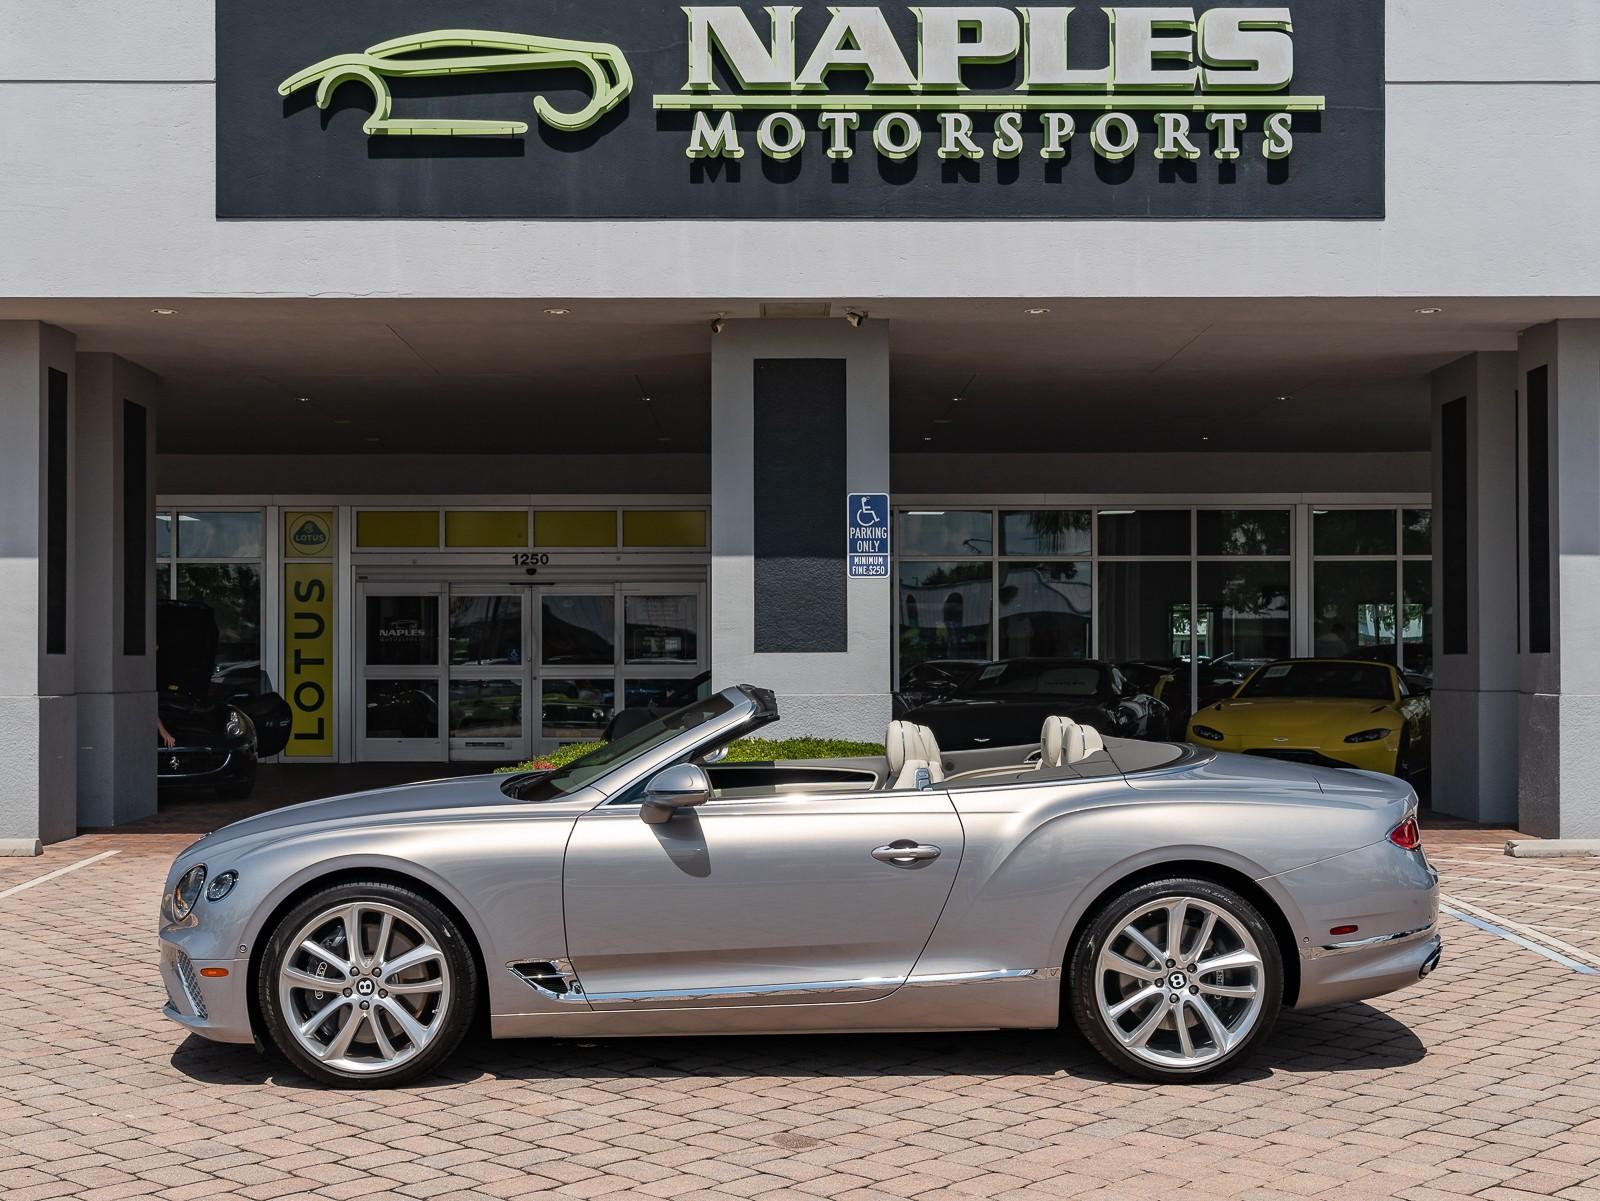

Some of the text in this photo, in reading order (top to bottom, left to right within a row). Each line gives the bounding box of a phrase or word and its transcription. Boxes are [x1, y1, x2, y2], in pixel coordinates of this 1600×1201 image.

[681, 6, 1293, 90] NAPLES
[685, 112, 1294, 159] MOTORSPORTS
[295, 534, 324, 542] LOTUS
[850, 527, 887, 539] PARKING
[857, 540, 880, 552] ONLY
[512, 553, 549, 566] 1250
[854, 556, 884, 565] MINIMUM
[852, 565, 885, 575] FINE $250
[379, 629, 425, 637] NAPLES
[294, 579, 325, 740] LOTUS
